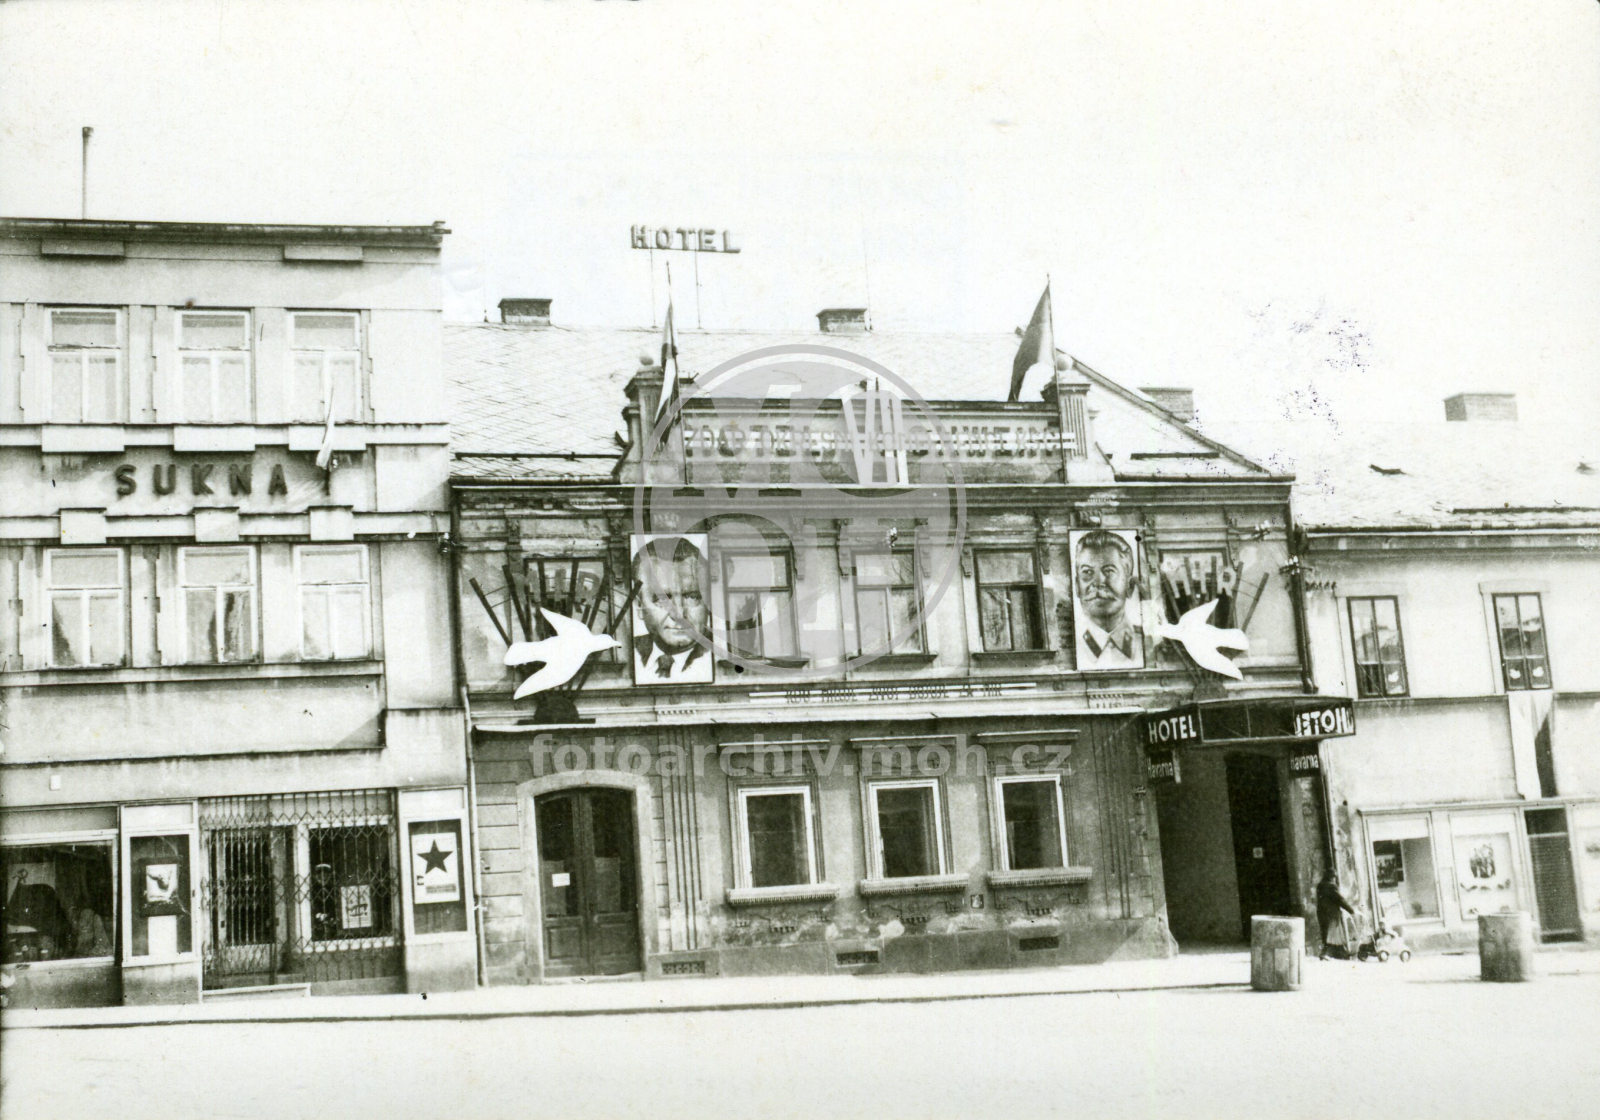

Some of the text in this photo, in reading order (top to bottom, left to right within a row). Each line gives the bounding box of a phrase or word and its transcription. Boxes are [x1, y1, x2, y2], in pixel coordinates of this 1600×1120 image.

[630, 224, 741, 254] HOTEL
[115, 463, 289, 496] SUKNA
[1148, 714, 1197, 744] HOTEL
